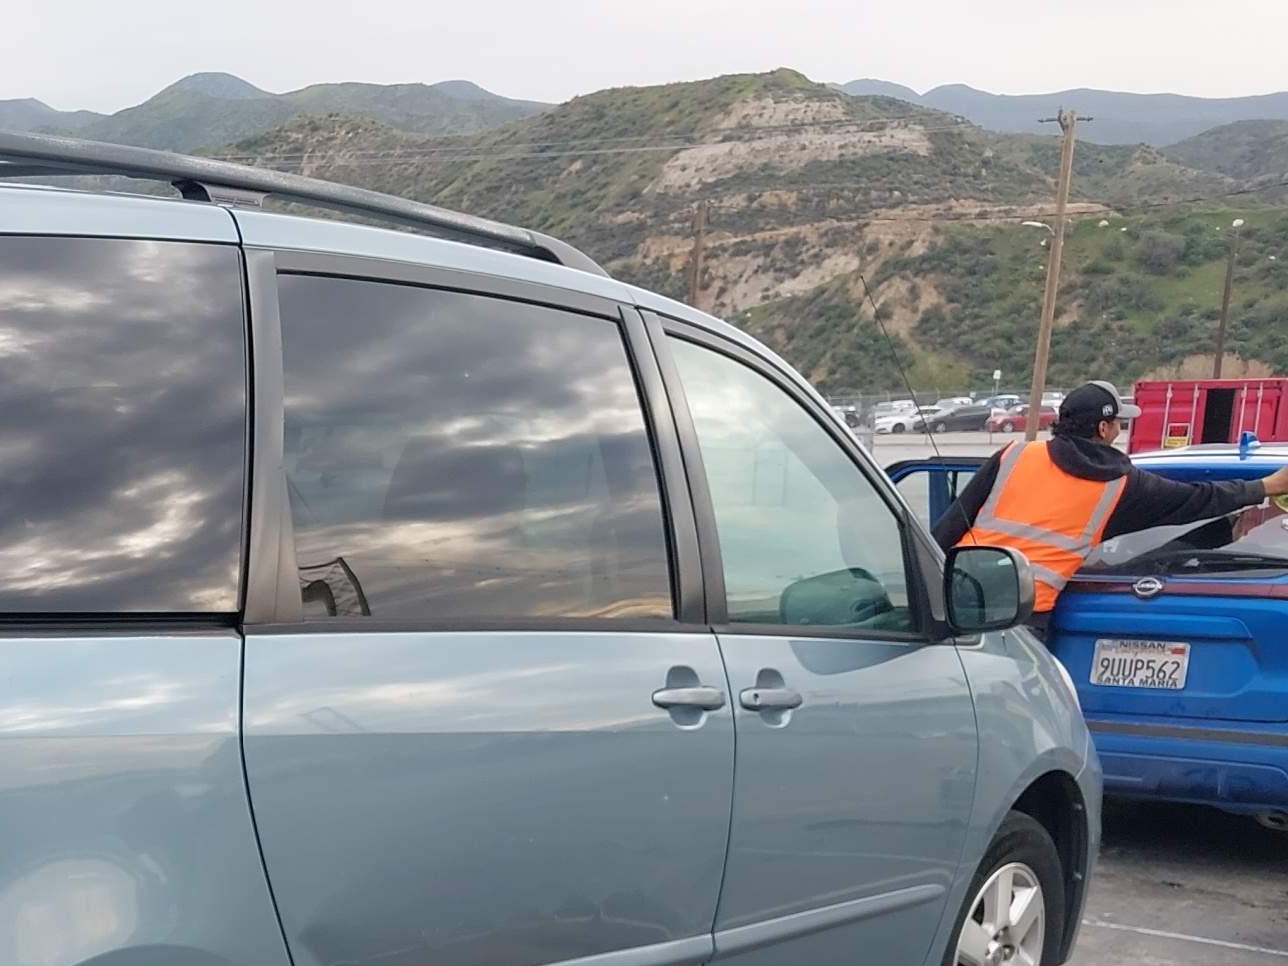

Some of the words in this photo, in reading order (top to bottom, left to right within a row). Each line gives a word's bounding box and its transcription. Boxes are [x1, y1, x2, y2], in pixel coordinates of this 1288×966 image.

[1119, 640, 1166, 650] NISSAN
[1100, 657, 1180, 680] 9UUP562
[1138, 679, 1178, 689] MARIA
